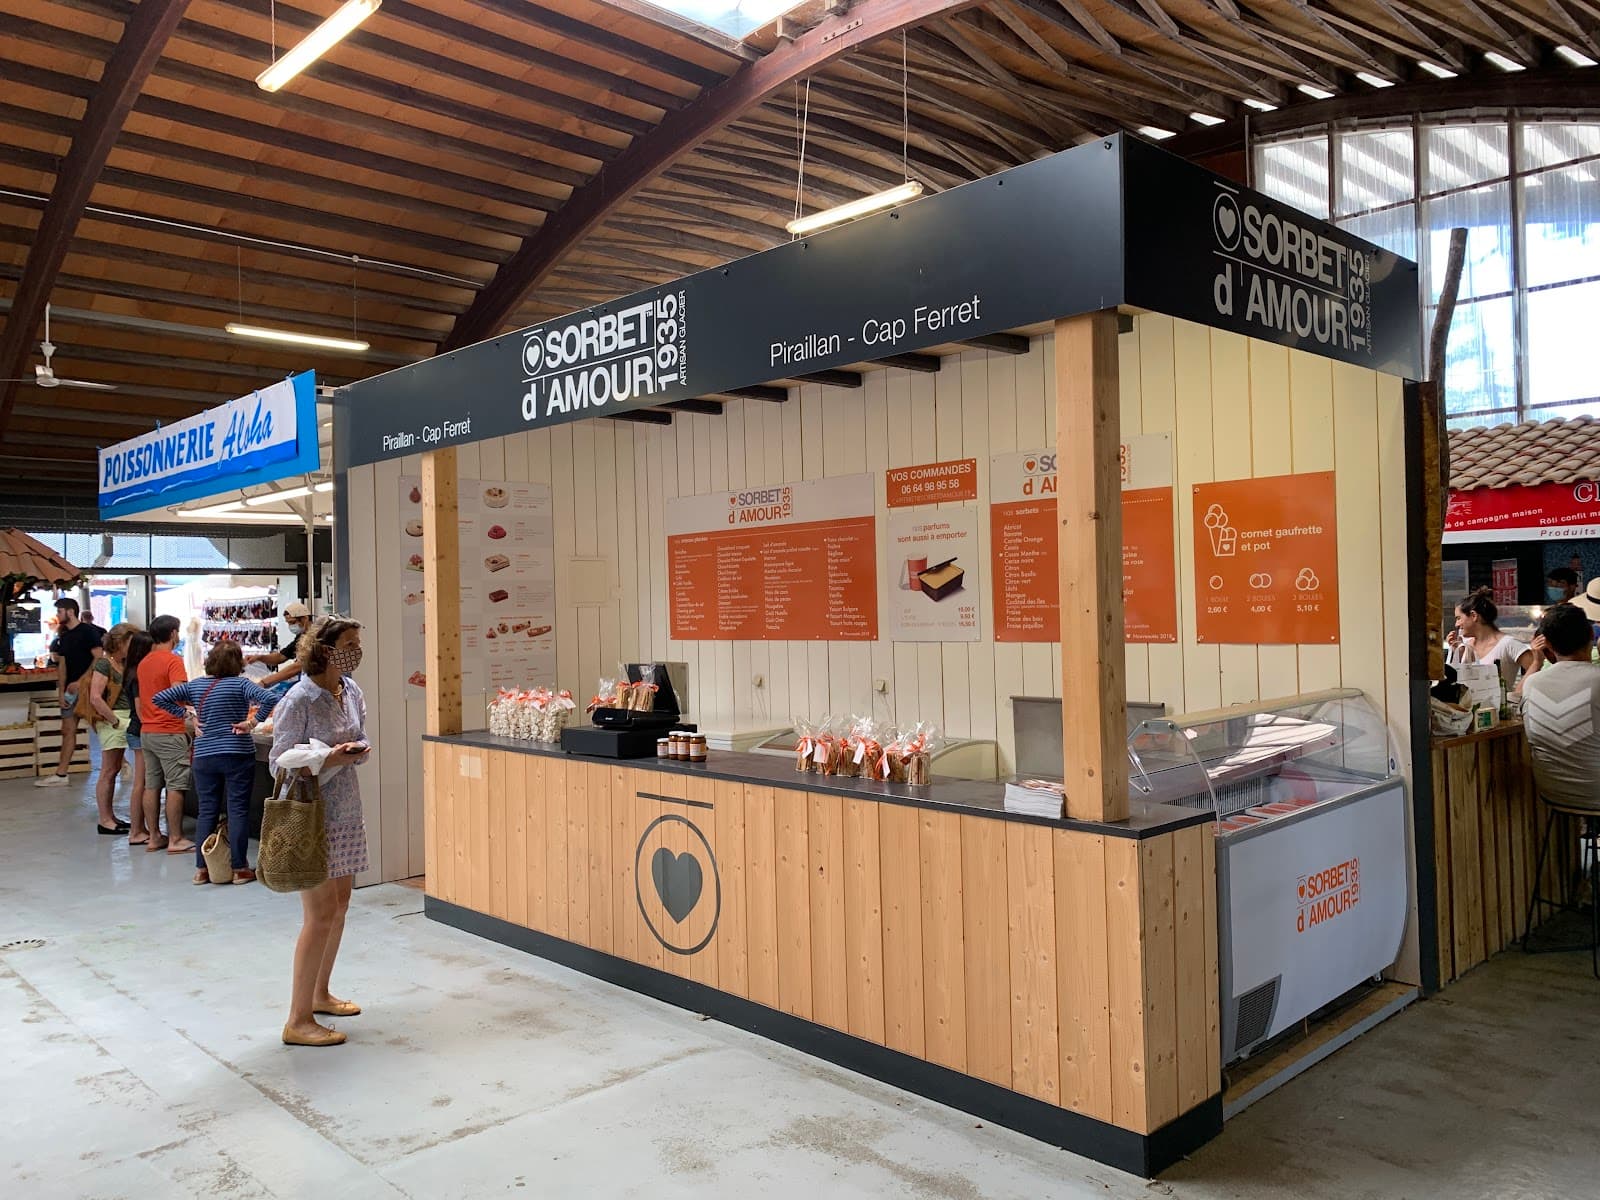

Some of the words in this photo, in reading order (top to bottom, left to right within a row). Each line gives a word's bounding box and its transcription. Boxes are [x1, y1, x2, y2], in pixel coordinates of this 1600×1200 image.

[1246, 274, 1349, 350] AMOUR
[1349, 248, 1366, 352] 1935
[678, 290, 687, 338] GLACIER
[656, 294, 678, 392] 1935
[770, 333, 840, 368] Piraillan
[862, 318, 906, 346] Cap
[914, 294, 980, 335] Ferret
[680, 340, 688, 386] ARTISAN
[546, 356, 655, 417] AMOUR
[103, 421, 216, 488] POISSONNERIE
[217, 397, 275, 471] Aloha
[383, 430, 415, 452] Piraillan
[422, 424, 442, 444] Cap
[443, 417, 472, 440] Ferret
[891, 472, 908, 483] VOS
[910, 463, 972, 480] COMMANDES
[738, 488, 781, 506] SORBET
[902, 484, 912, 494] 06
[912, 483, 923, 493] 64
[924, 482, 935, 492] 98
[936, 480, 947, 490] 95
[948, 479, 960, 488] 58
[740, 506, 782, 523] AMOUR
[782, 487, 791, 519] 1935
[1016, 508, 1040, 516] sorbets
[923, 522, 950, 532] parfums
[1467, 513, 1510, 526] campagne
[1512, 508, 1543, 518] maison
[1540, 517, 1558, 526] Rôti
[1561, 514, 1588, 523] confit
[936, 531, 968, 540] emporter
[1240, 529, 1272, 540] cornet
[1276, 526, 1323, 538] gaufrette
[1540, 529, 1597, 537] Produits
[1240, 543, 1252, 552] et
[1253, 542, 1271, 553] pot
[1308, 861, 1350, 900] SORBET
[1309, 889, 1351, 928] AMOUR
